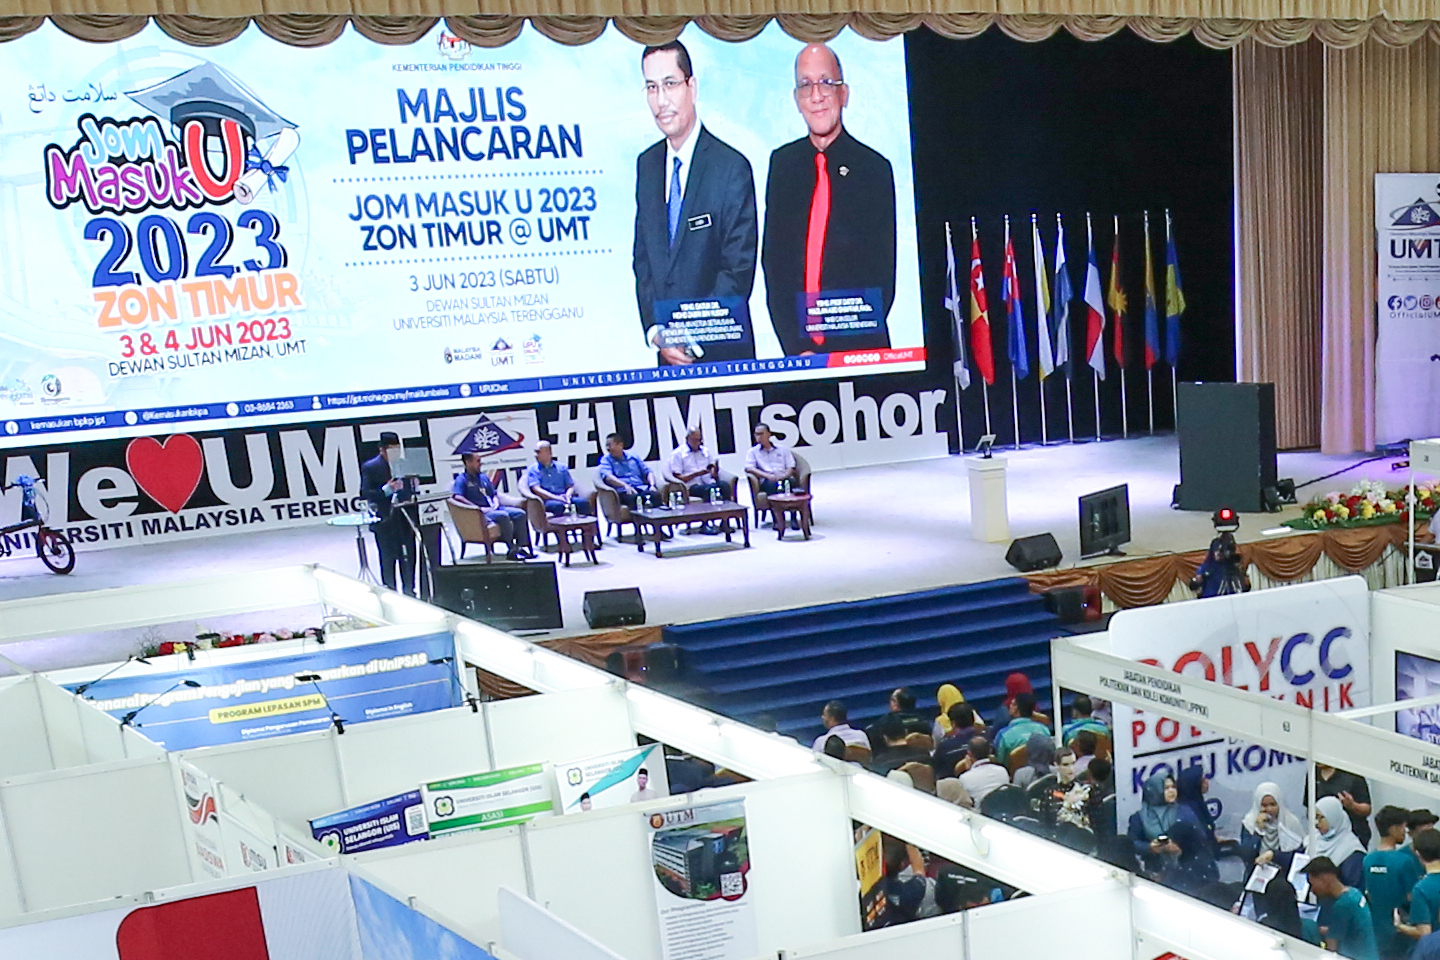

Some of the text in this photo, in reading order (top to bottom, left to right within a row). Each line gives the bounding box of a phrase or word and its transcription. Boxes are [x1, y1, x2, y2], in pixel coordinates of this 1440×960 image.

[396, 86, 528, 124] MAJLIS
[80, 117, 161, 165] Jom
[345, 124, 584, 165] PELANCARAN
[50, 118, 243, 207] Masuk U
[348, 186, 597, 221] JOM MASUK U 2023
[83, 209, 289, 288] 2023
[360, 215, 591, 251] ZON TIMUR @ UMT
[409, 266, 560, 292] 3 JUN 2023 (SABTU)
[93, 272, 303, 328] ZON TIMUR
[393, 306, 584, 331] UNIVERSITI MALAYSIA TERENGGANU
[426, 293, 550, 313] DEWAN SULTAN MIZAN
[120, 317, 292, 358] 3 & 4 JUN 2023
[108, 340, 307, 377] DEWAN SULTAN MIZAN, UMT
[561, 356, 813, 387] UNIVERSITI MALAYSIA TERENGGANU
[547, 382, 948, 472] #UMTsohor
[140, 506, 265, 543] MALAYSIA
[665, 808, 695, 827] UTM
